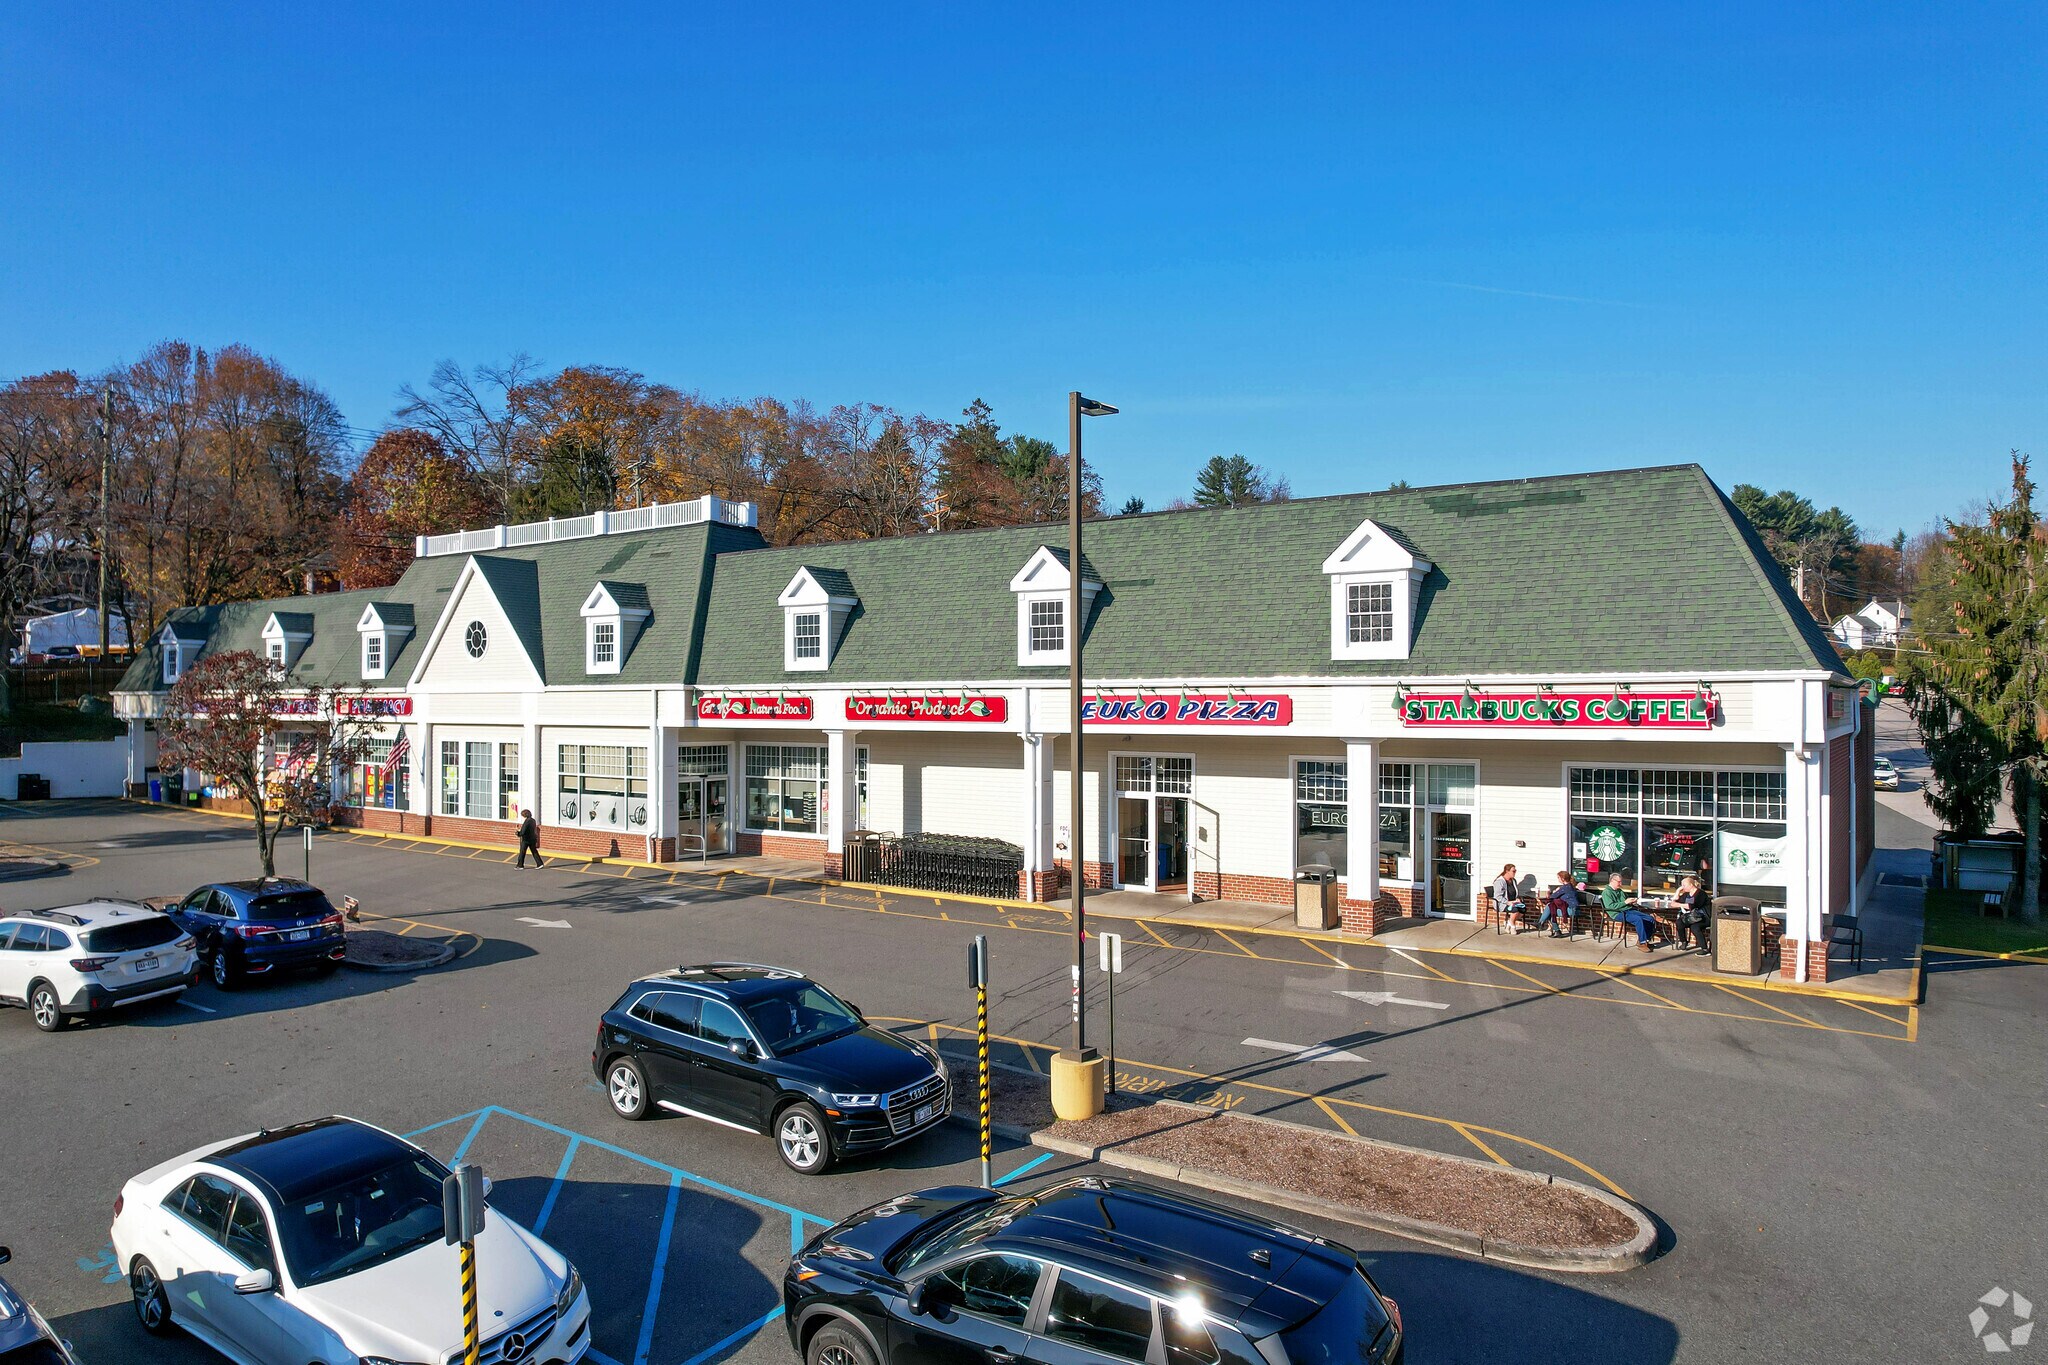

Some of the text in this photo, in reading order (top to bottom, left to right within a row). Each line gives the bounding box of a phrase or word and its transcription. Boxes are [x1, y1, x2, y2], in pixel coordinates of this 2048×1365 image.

[1082, 700, 1281, 720] EURO PIZZA
[1405, 699, 1708, 722] STARBUCKS COFFEE
